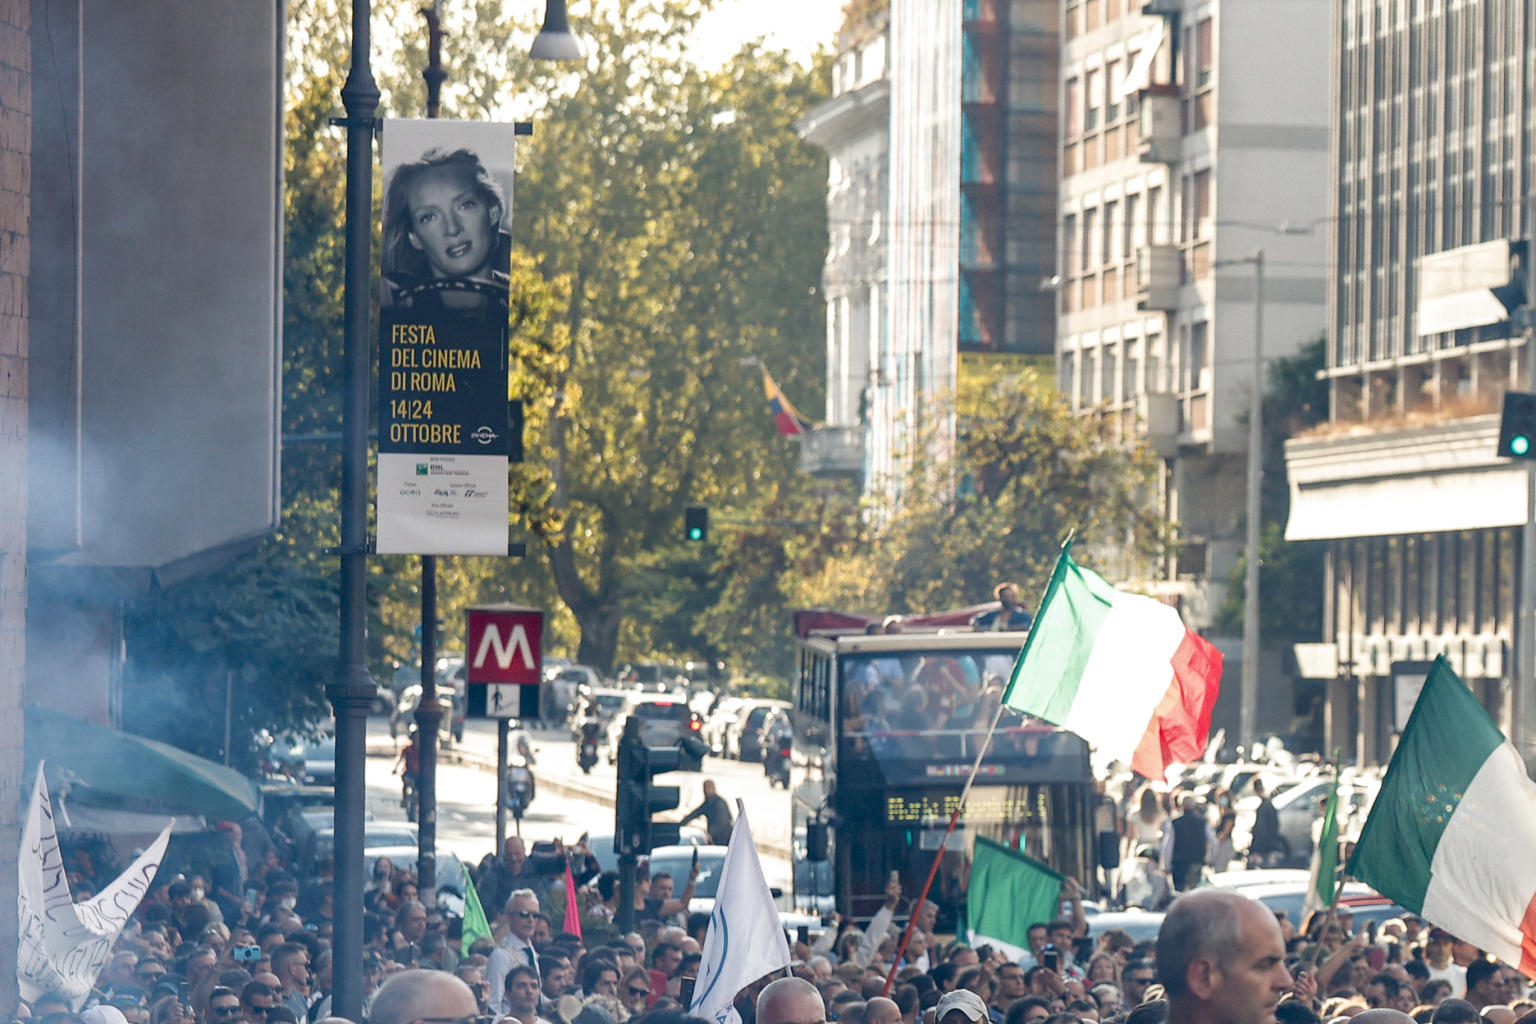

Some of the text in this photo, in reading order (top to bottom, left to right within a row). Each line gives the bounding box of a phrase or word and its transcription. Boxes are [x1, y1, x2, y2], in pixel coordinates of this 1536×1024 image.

[391, 324, 436, 345] FESTA
[391, 348, 482, 369] DEL CINEMA
[391, 371, 457, 392] DI ROMA
[390, 423, 462, 444] OTTOBRE
[473, 623, 536, 670] M
